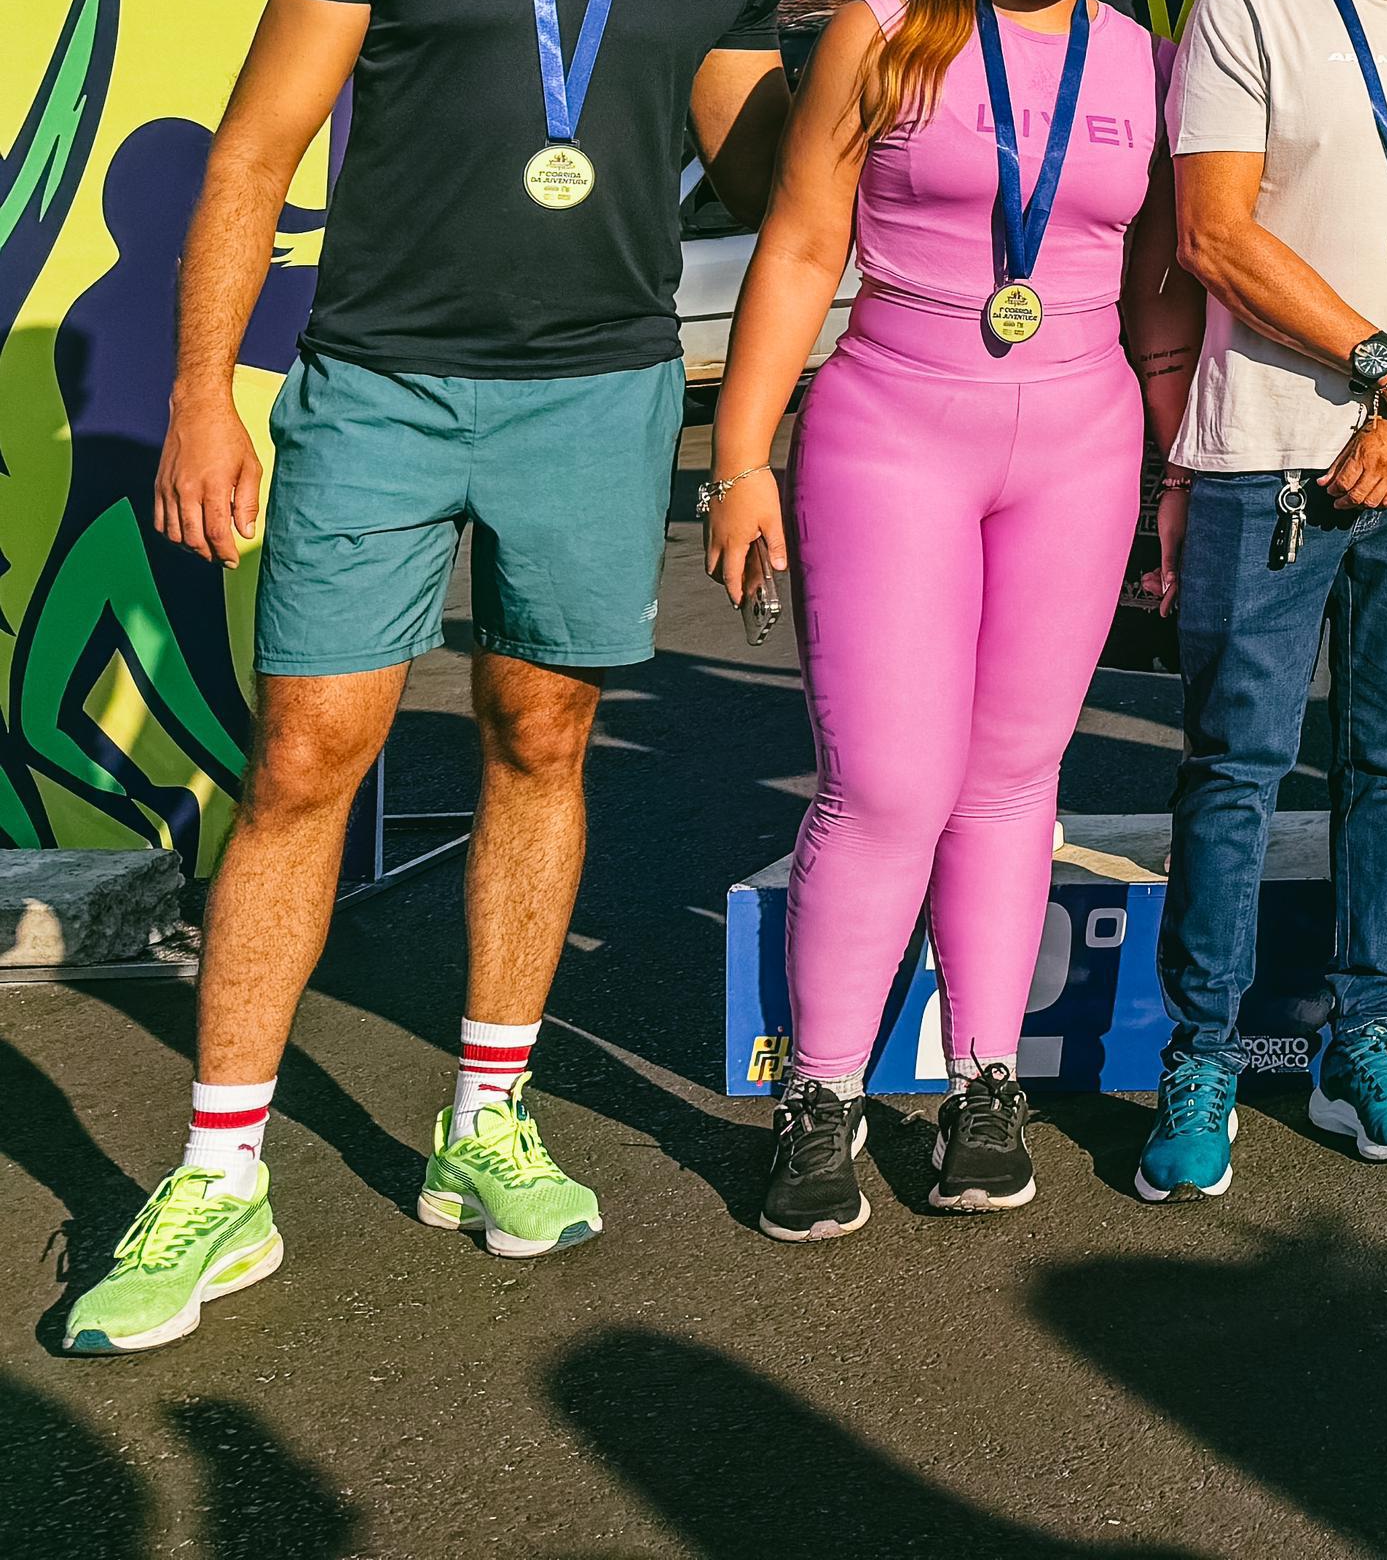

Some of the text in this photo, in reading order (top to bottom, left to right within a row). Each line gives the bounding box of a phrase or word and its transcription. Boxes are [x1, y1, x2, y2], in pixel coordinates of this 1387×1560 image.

[976, 103, 1134, 149] LIE!
[1241, 1037, 1309, 1055] PORTO
[1251, 1053, 1309, 1070] RANCO
